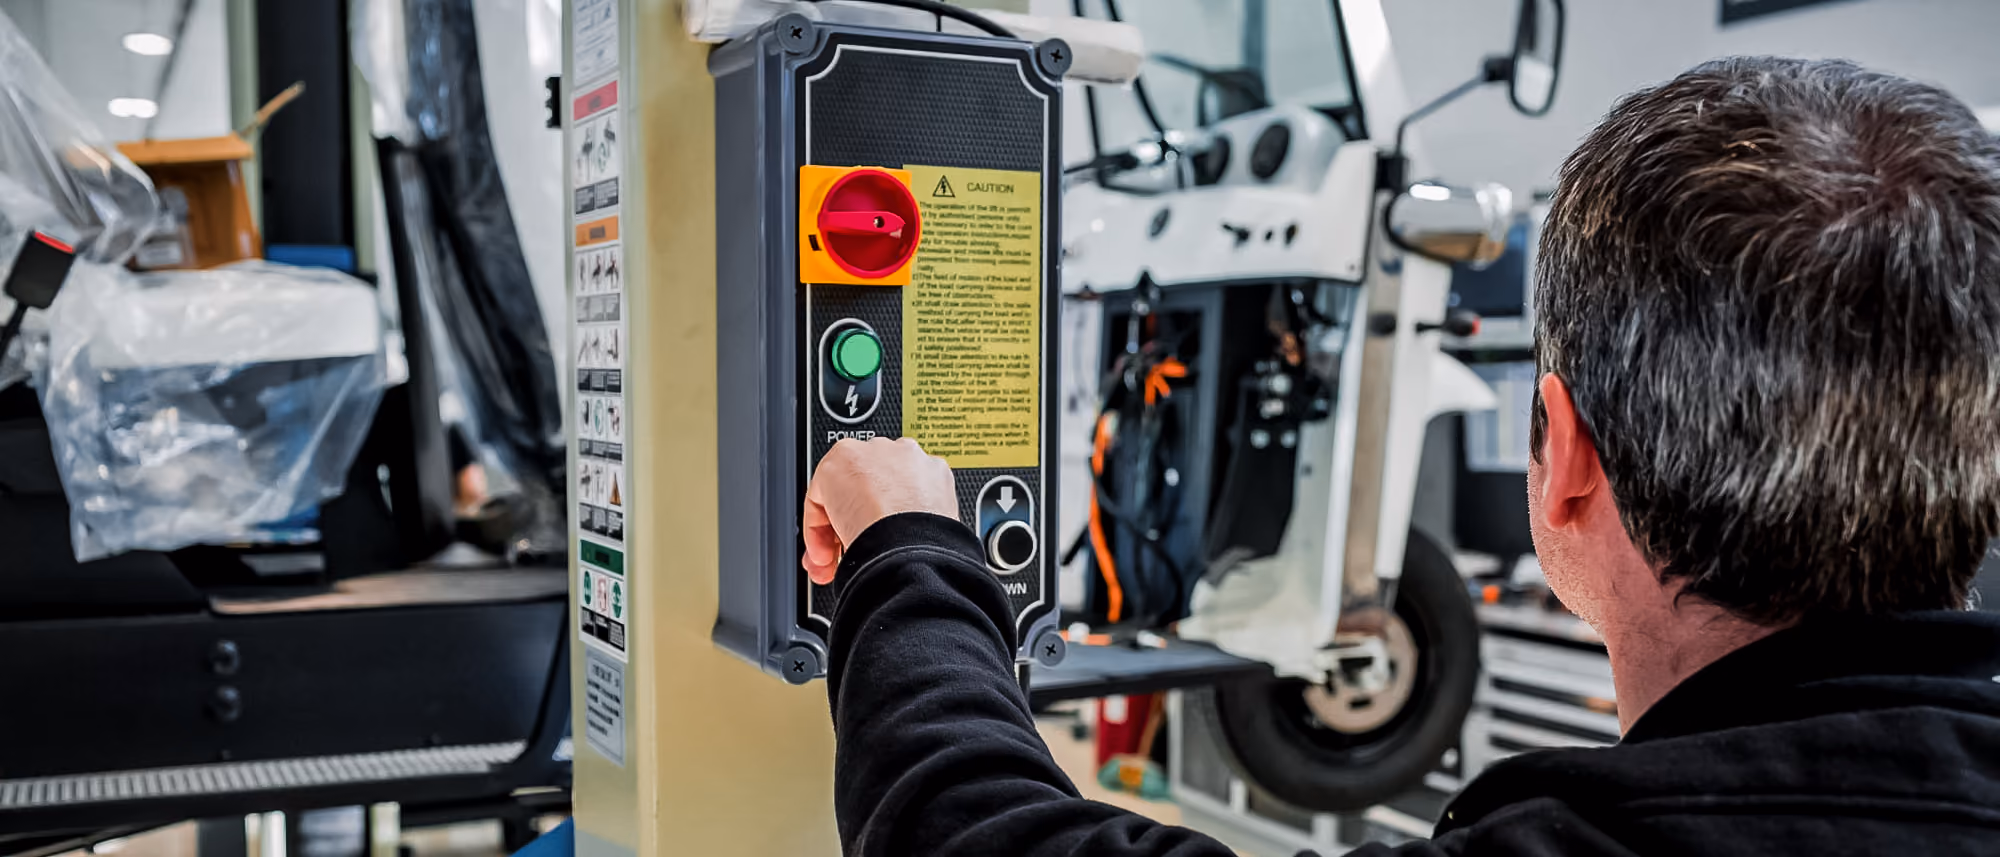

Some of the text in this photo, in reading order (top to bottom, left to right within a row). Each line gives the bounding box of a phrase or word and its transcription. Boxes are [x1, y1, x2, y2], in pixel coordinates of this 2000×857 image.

[967, 182, 1014, 193] CAUTION
[827, 431, 876, 443] POWER
[1001, 583, 1027, 595] WN
